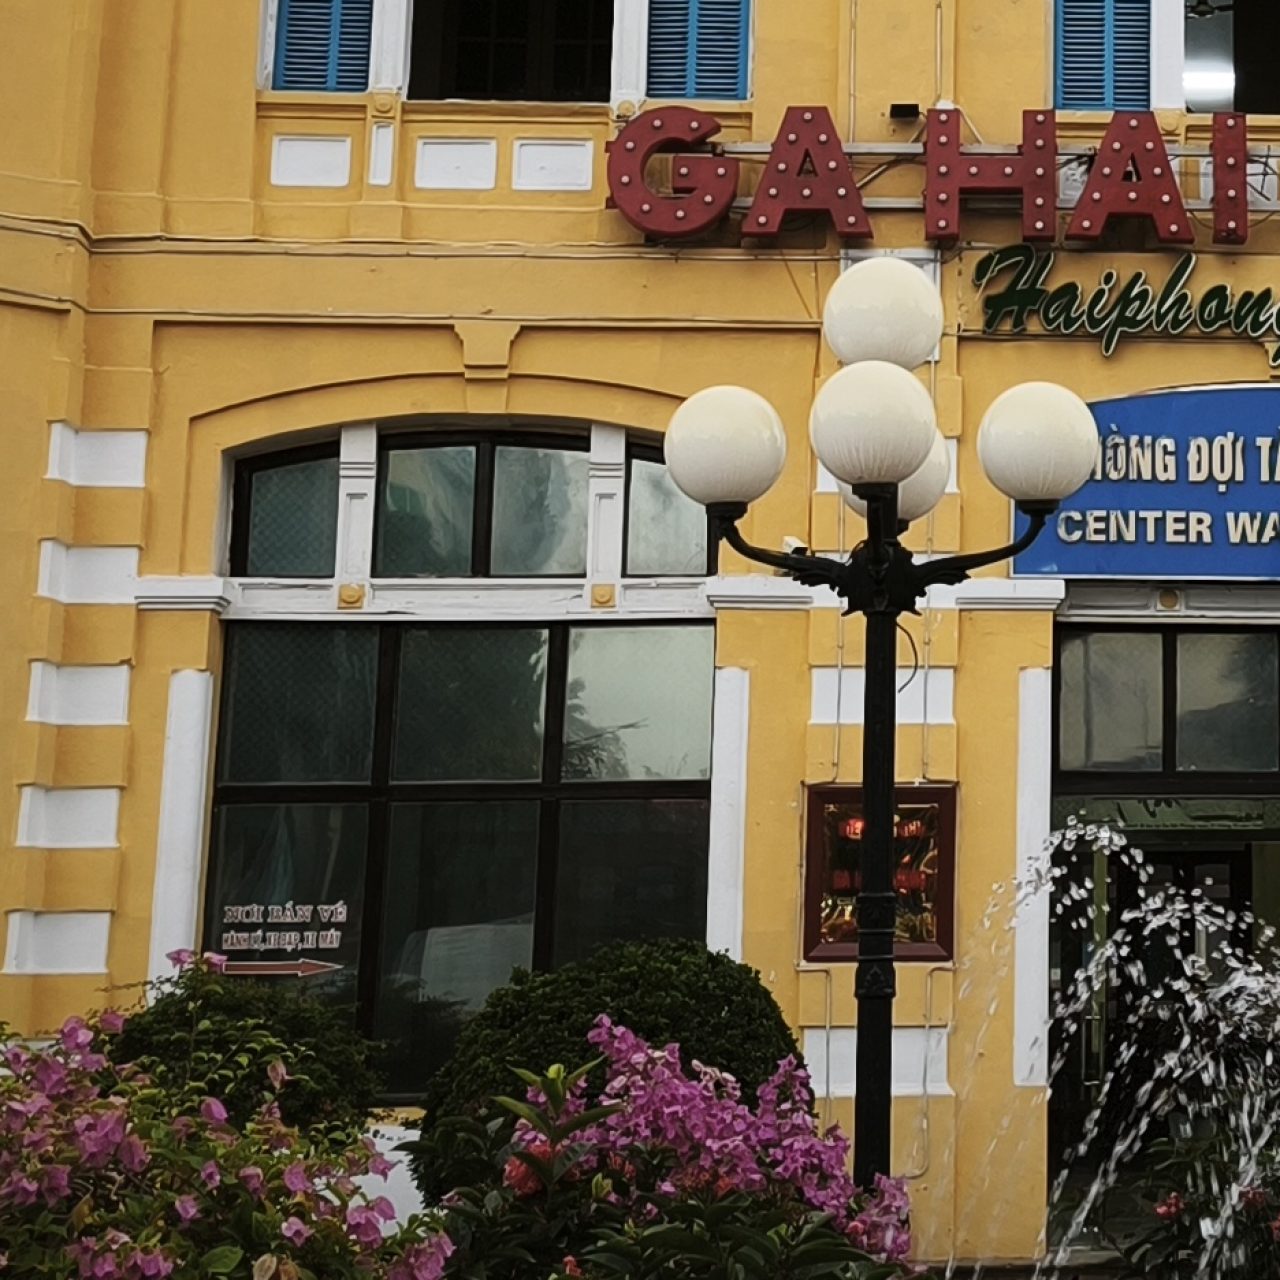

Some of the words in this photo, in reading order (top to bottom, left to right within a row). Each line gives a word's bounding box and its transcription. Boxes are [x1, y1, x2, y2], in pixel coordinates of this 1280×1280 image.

[606, 105, 874, 239] GA
[924, 108, 1248, 244] HAI
[1092, 423, 1177, 481] ÒNG
[1056, 509, 1213, 543] CENTER
